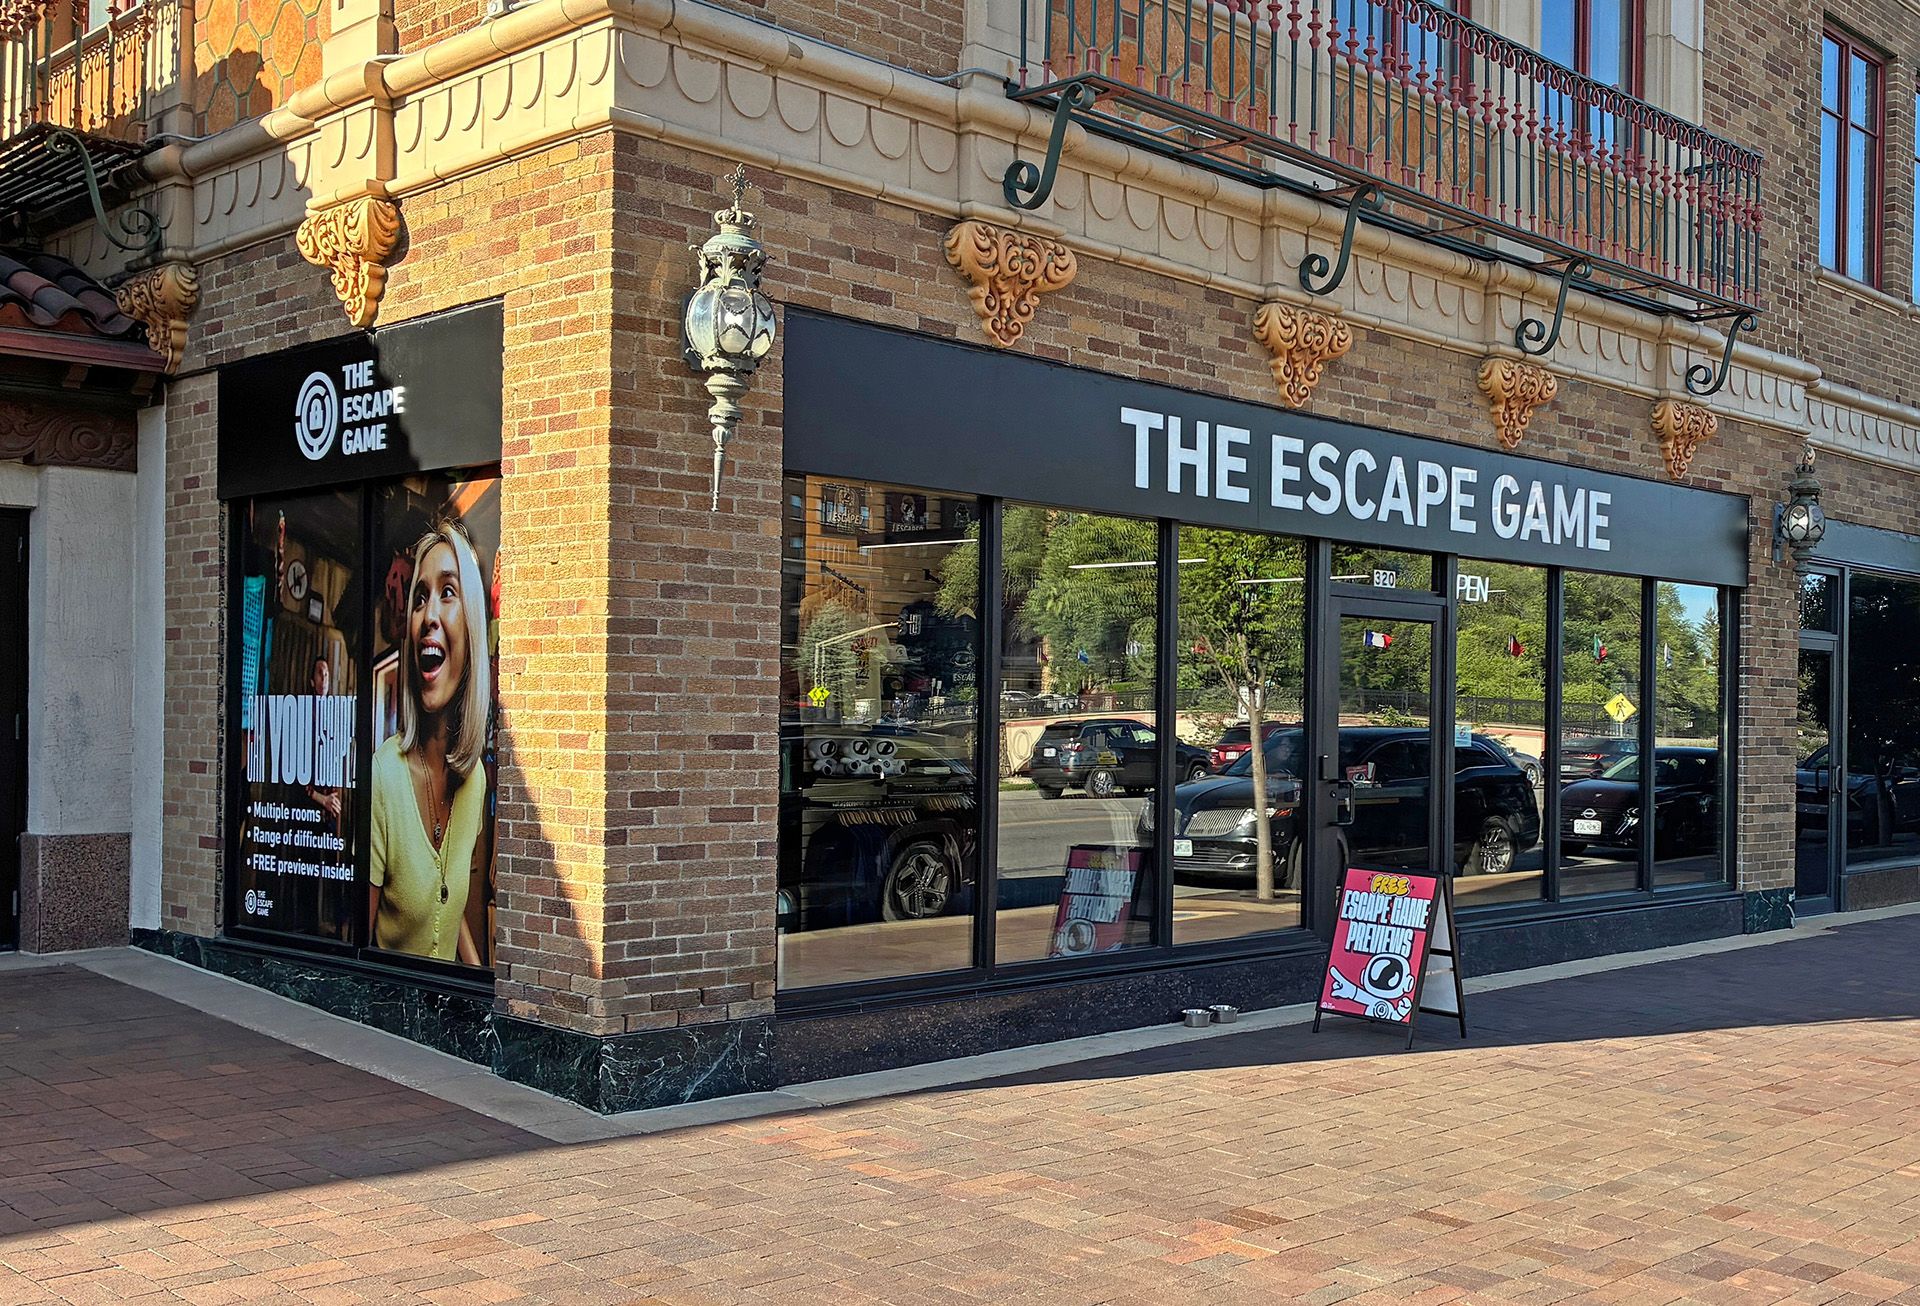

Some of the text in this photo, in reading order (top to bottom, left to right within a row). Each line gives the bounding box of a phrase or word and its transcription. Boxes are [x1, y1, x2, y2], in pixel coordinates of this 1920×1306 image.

[342, 360, 374, 390] THE
[342, 386, 406, 423] ESCAPE
[342, 423, 387, 455] GAME
[1120, 407, 1612, 551] THE ESCAPE GAME
[1375, 572, 1395, 587] 320
[1456, 574, 1489, 602] PEN
[247, 695, 265, 783] CAN
[268, 694, 313, 785] YOU
[253, 801, 321, 823] Multiple rooms
[253, 826, 344, 851] Range of difficulties
[253, 854, 354, 881] FREE previews inside!
[1372, 875, 1409, 896] FREE
[257, 899, 273, 908] ESCAPE
[1341, 890, 1431, 929] ESCAPE GAME
[1345, 921, 1414, 957] PREVIEWS
